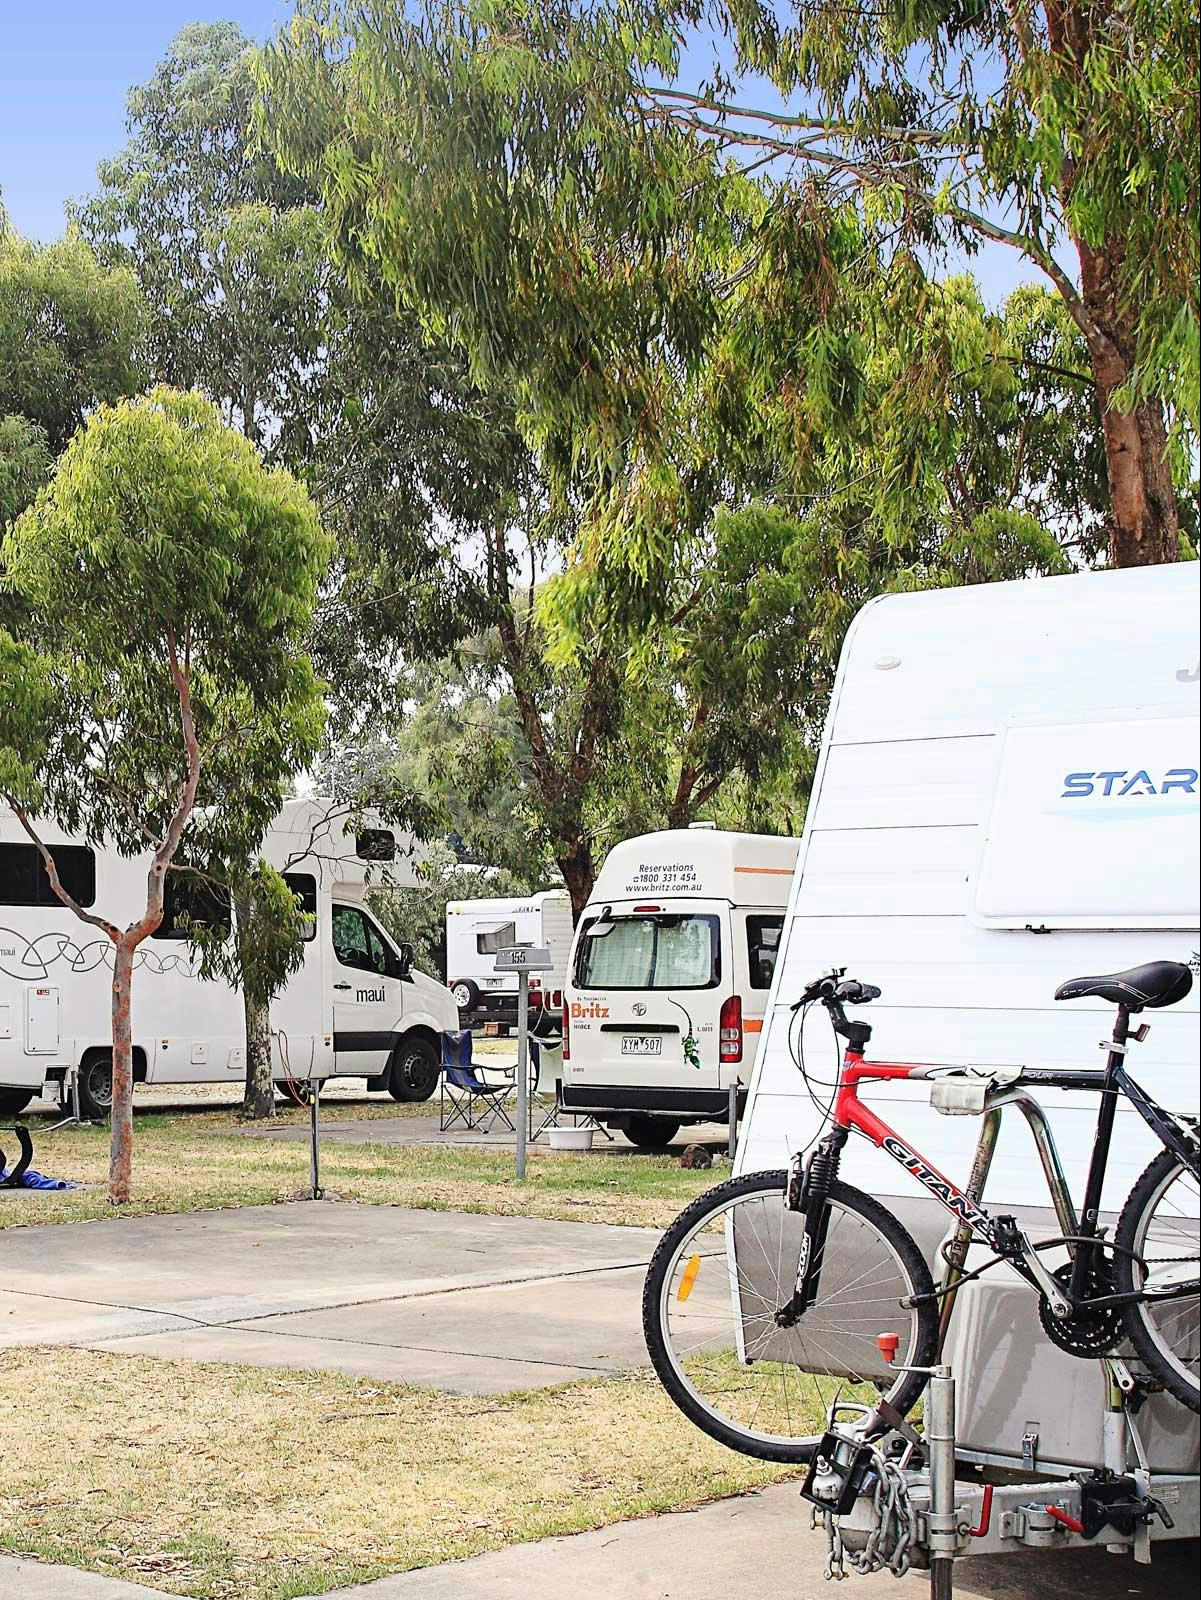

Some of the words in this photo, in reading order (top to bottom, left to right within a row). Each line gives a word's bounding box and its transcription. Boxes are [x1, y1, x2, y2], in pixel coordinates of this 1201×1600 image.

[1060, 768, 1198, 797] STAR
[638, 862, 695, 873] Reservations
[640, 874, 659, 883] 1800
[662, 873, 677, 883] 331
[680, 873, 697, 882] 454
[625, 883, 703, 892] www.britz.com.au
[356, 985, 385, 1002] maui
[571, 1001, 610, 1018] Britz
[645, 1039, 660, 1050] 507
